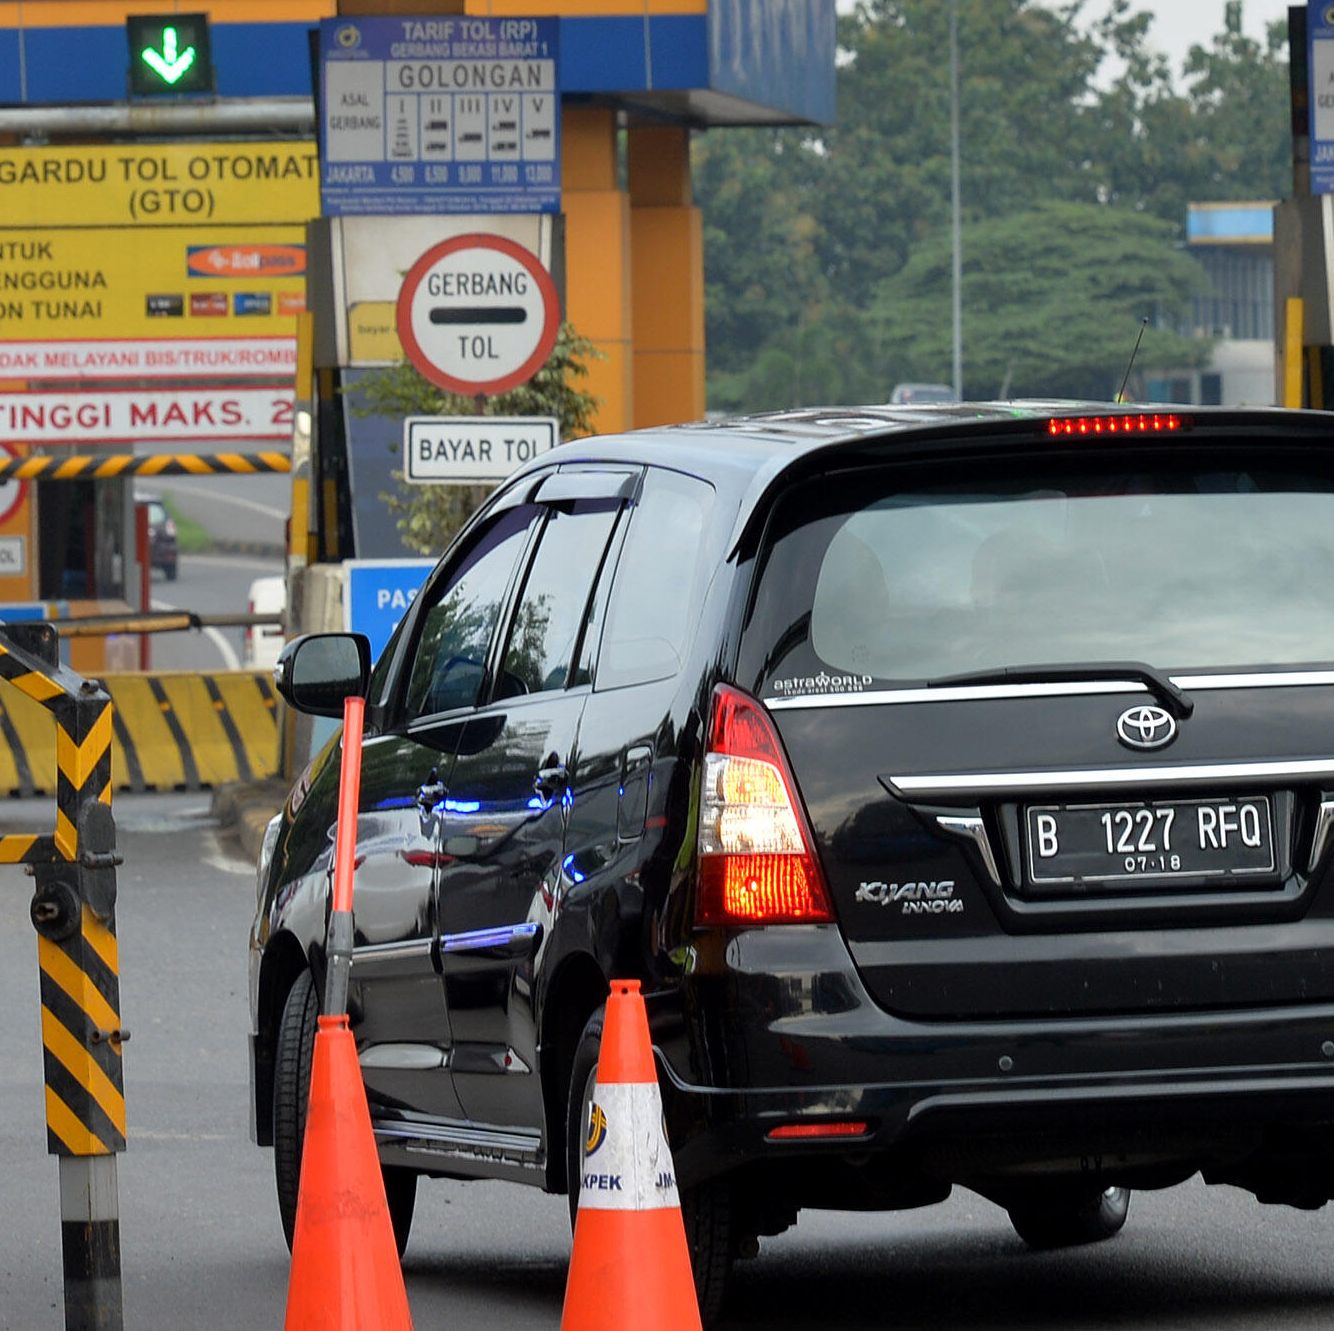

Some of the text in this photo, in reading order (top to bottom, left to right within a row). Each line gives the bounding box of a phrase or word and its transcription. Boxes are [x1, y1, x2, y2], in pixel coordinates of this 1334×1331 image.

[402, 20, 538, 40] TARIF TOL (RP)
[391, 43, 450, 57] GERBANG
[453, 42, 496, 57] BEKASI
[499, 42, 538, 56] BARAT
[399, 64, 541, 88] GOLONGAN
[494, 98, 513, 113] IV
[533, 98, 544, 113] V
[330, 116, 381, 130] GERBANG
[119, 157, 177, 182] TOL
[327, 166, 375, 183] JAKARTA
[129, 188, 214, 219] (GTO)
[428, 272, 527, 297] GERBANG
[31, 300, 102, 319] TUNAI
[458, 335, 499, 359] TOL
[46, 350, 138, 368] MELAYANI
[131, 401, 251, 427] MAKS.
[420, 439, 492, 462] BAYAR
[1037, 803, 1261, 857] B 1227 RFQ
[902, 899, 964, 914] INNOVA
